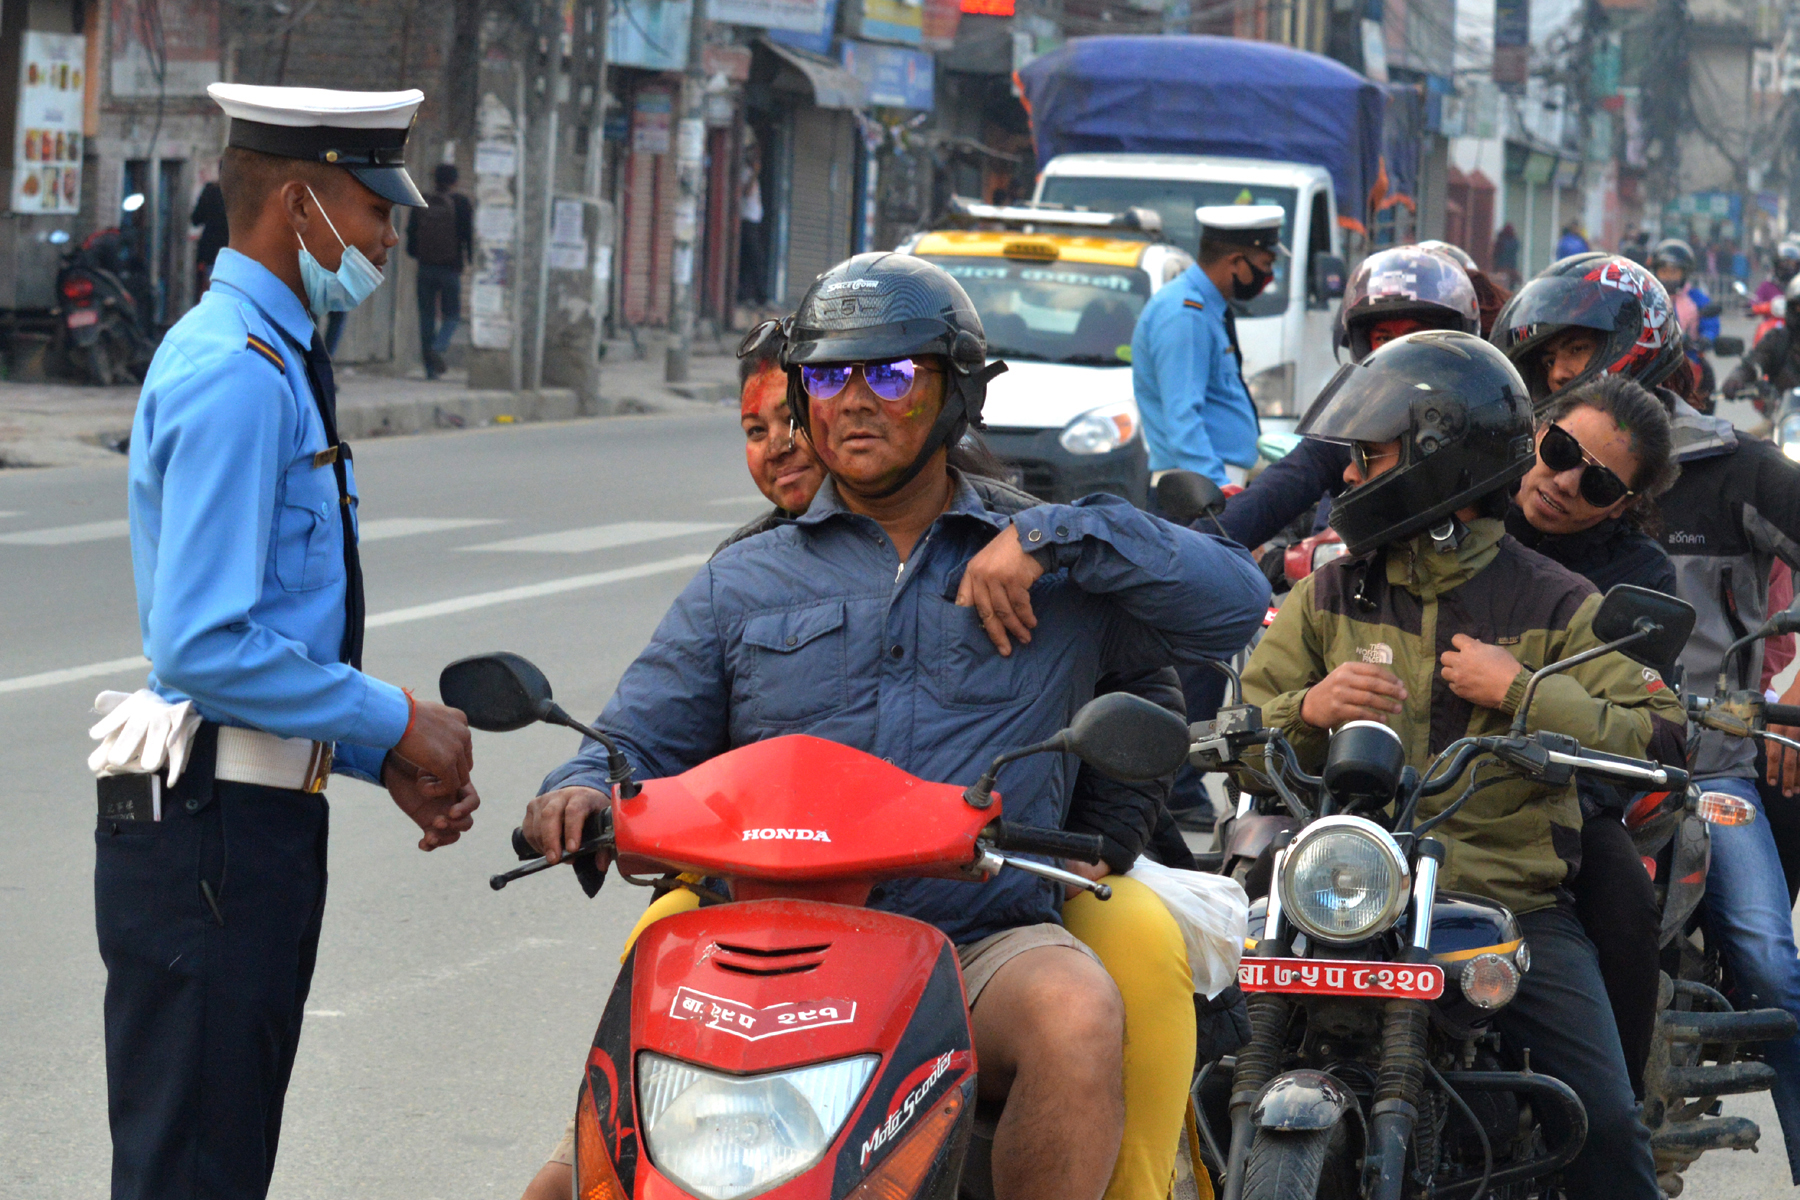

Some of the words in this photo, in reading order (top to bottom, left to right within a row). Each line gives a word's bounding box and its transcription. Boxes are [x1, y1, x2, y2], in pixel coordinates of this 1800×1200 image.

[1356, 646, 1379, 657] NORTH
[1362, 655, 1380, 664] FACE
[742, 828, 832, 842] HONDA
